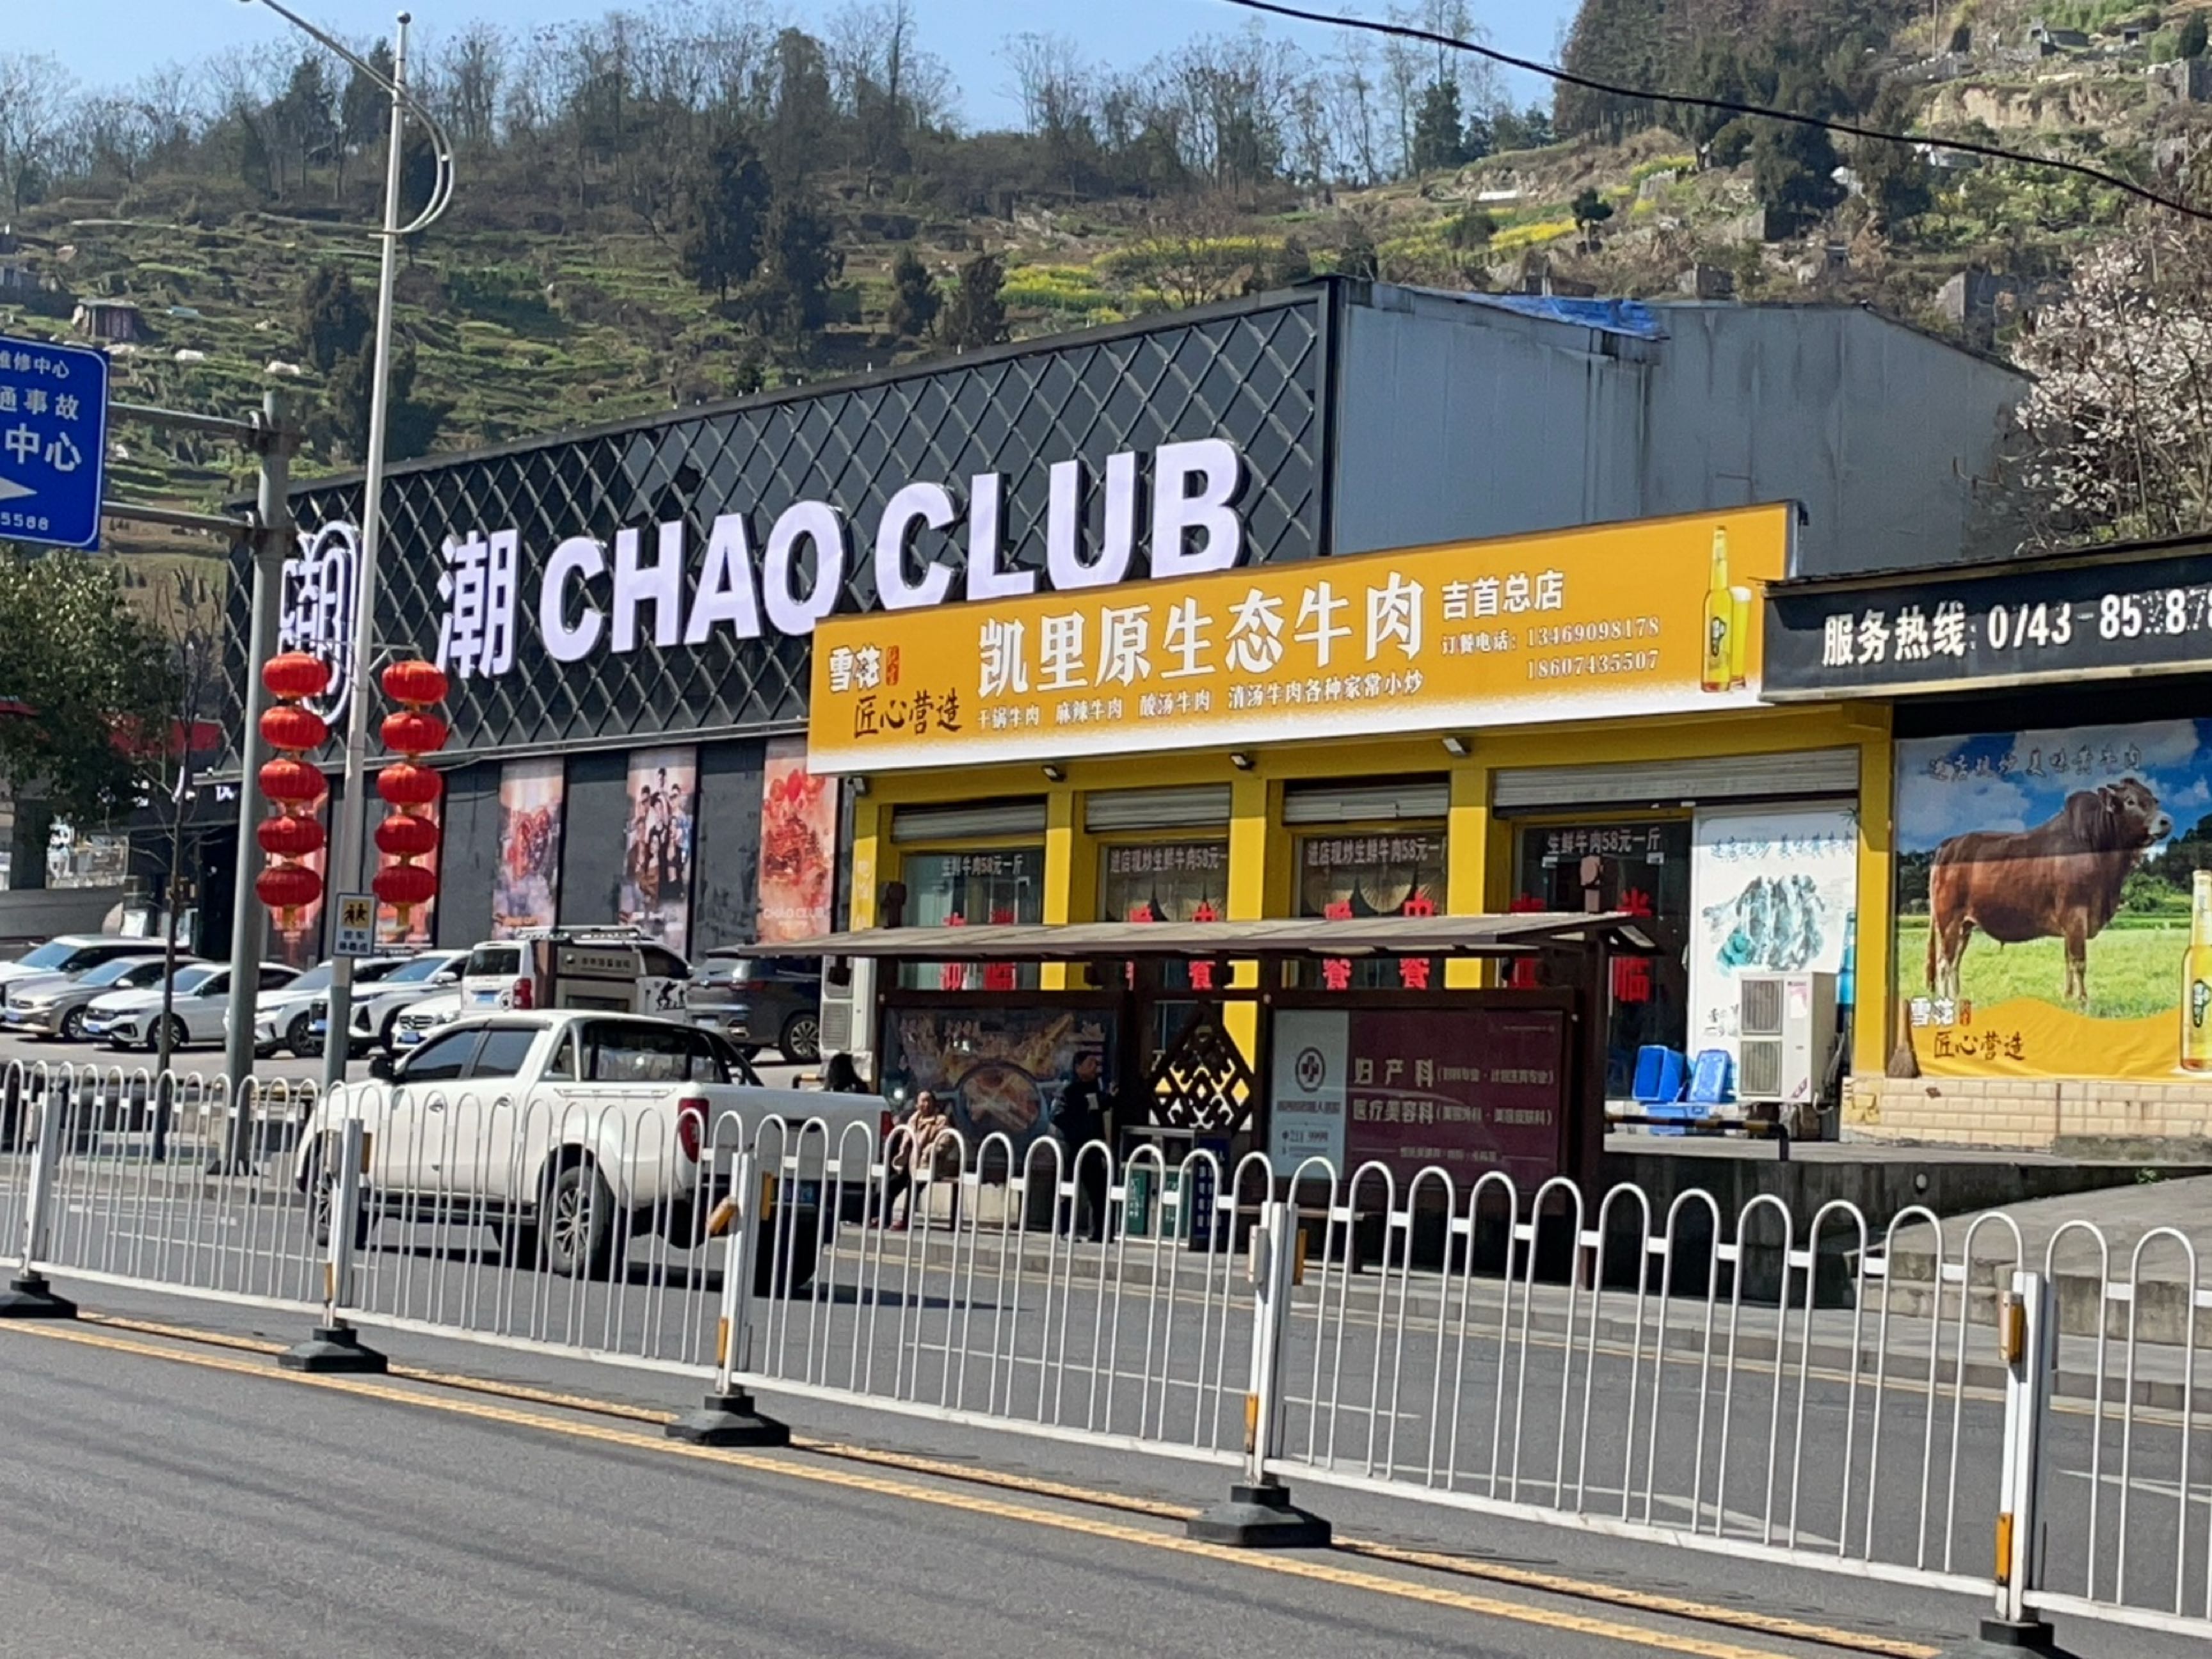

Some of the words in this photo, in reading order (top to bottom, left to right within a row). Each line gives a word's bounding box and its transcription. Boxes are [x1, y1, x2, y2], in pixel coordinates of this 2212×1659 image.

[5, 422, 83, 472] 中心
[540, 499, 846, 663] CHAO
[875, 437, 1244, 612] CLUB
[437, 529, 519, 679] 潮
[1441, 570, 1564, 621] 吉首总店
[977, 570, 1425, 699] 凯里原生态牛肉
[1527, 616, 1660, 647] 13469098178
[1527, 650, 1660, 680] 18607435507
[853, 687, 963, 739] 匠心营造
[977, 704, 1041, 730] 干锅牛肉
[1056, 696, 1123, 725] 麻辣牛肉
[1139, 689, 1210, 717] 酸汤牛肉
[1228, 669, 1423, 709] 清汤牛肉各种家常小炒
[1934, 1030, 2025, 1061] 匠心营造
